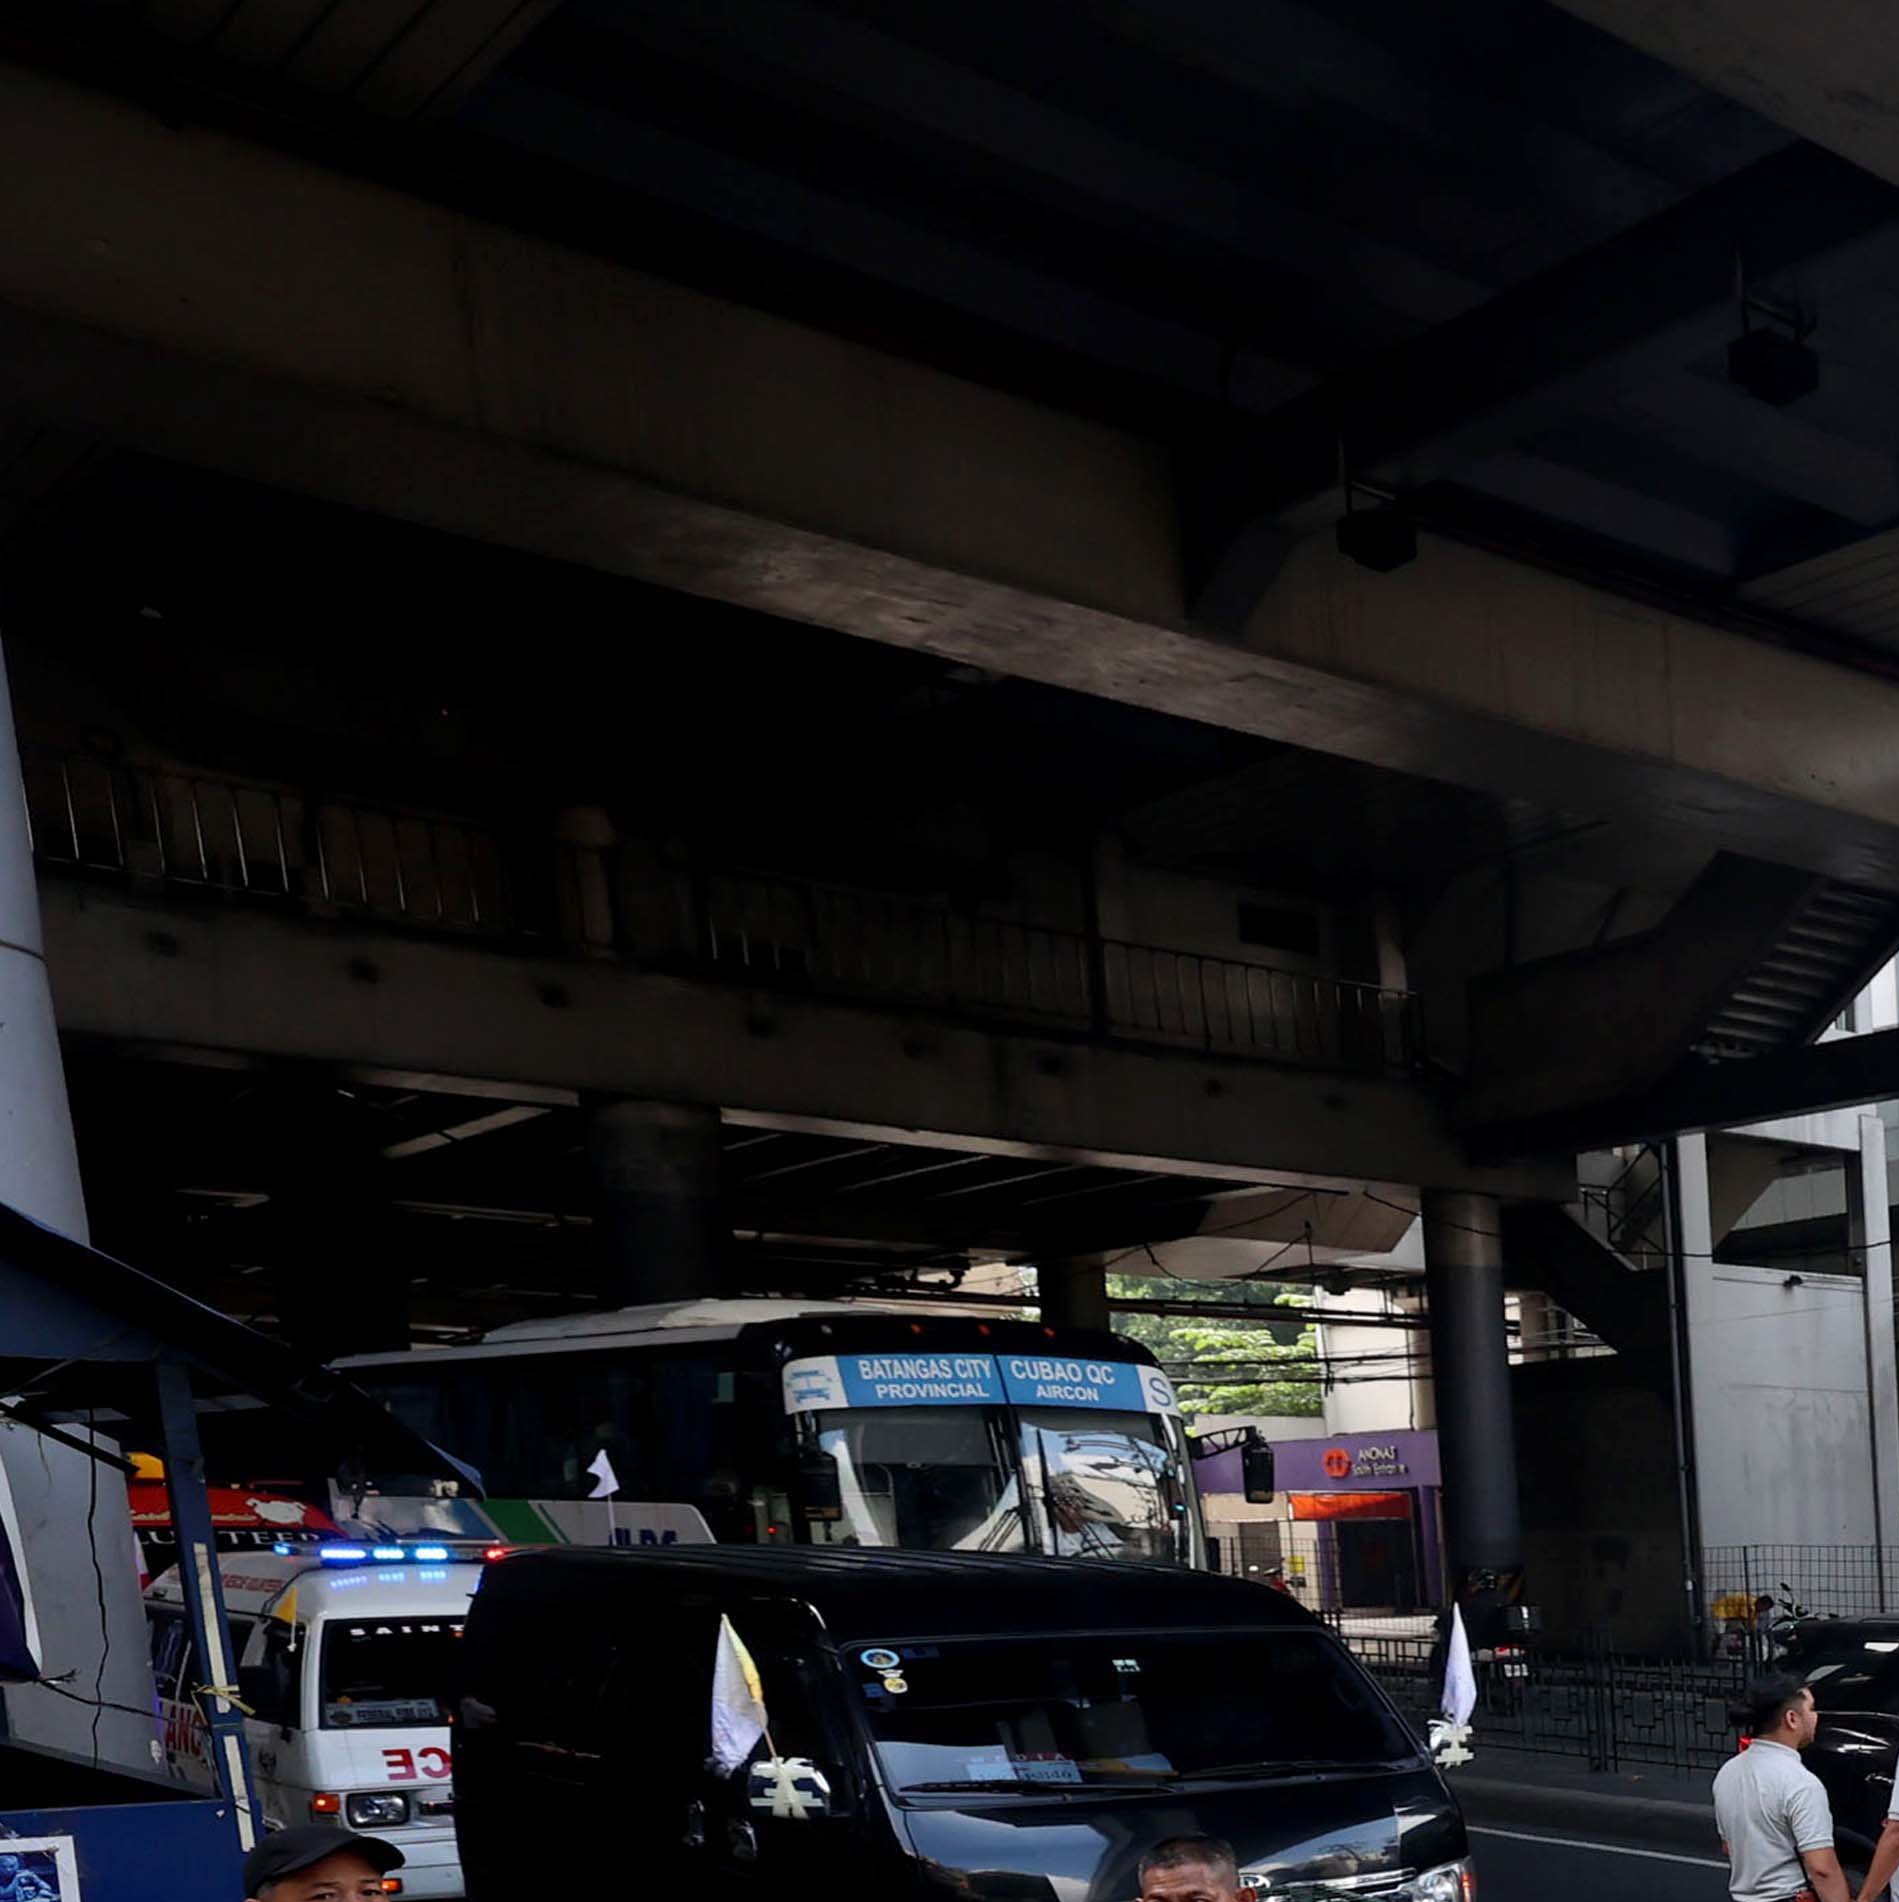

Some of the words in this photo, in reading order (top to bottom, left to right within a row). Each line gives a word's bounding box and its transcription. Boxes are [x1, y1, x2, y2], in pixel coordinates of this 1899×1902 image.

[858, 1359, 952, 1381] BATANGAS
[955, 1360, 991, 1380] CITY
[1010, 1360, 1084, 1383] CUBAO
[1085, 1365, 1115, 1386] QC
[875, 1382, 990, 1400] PROVINCIAL
[1036, 1385, 1099, 1402] AIRCON
[1358, 1445, 1396, 1461] ANONAS
[350, 1624, 465, 1636] SAINT
